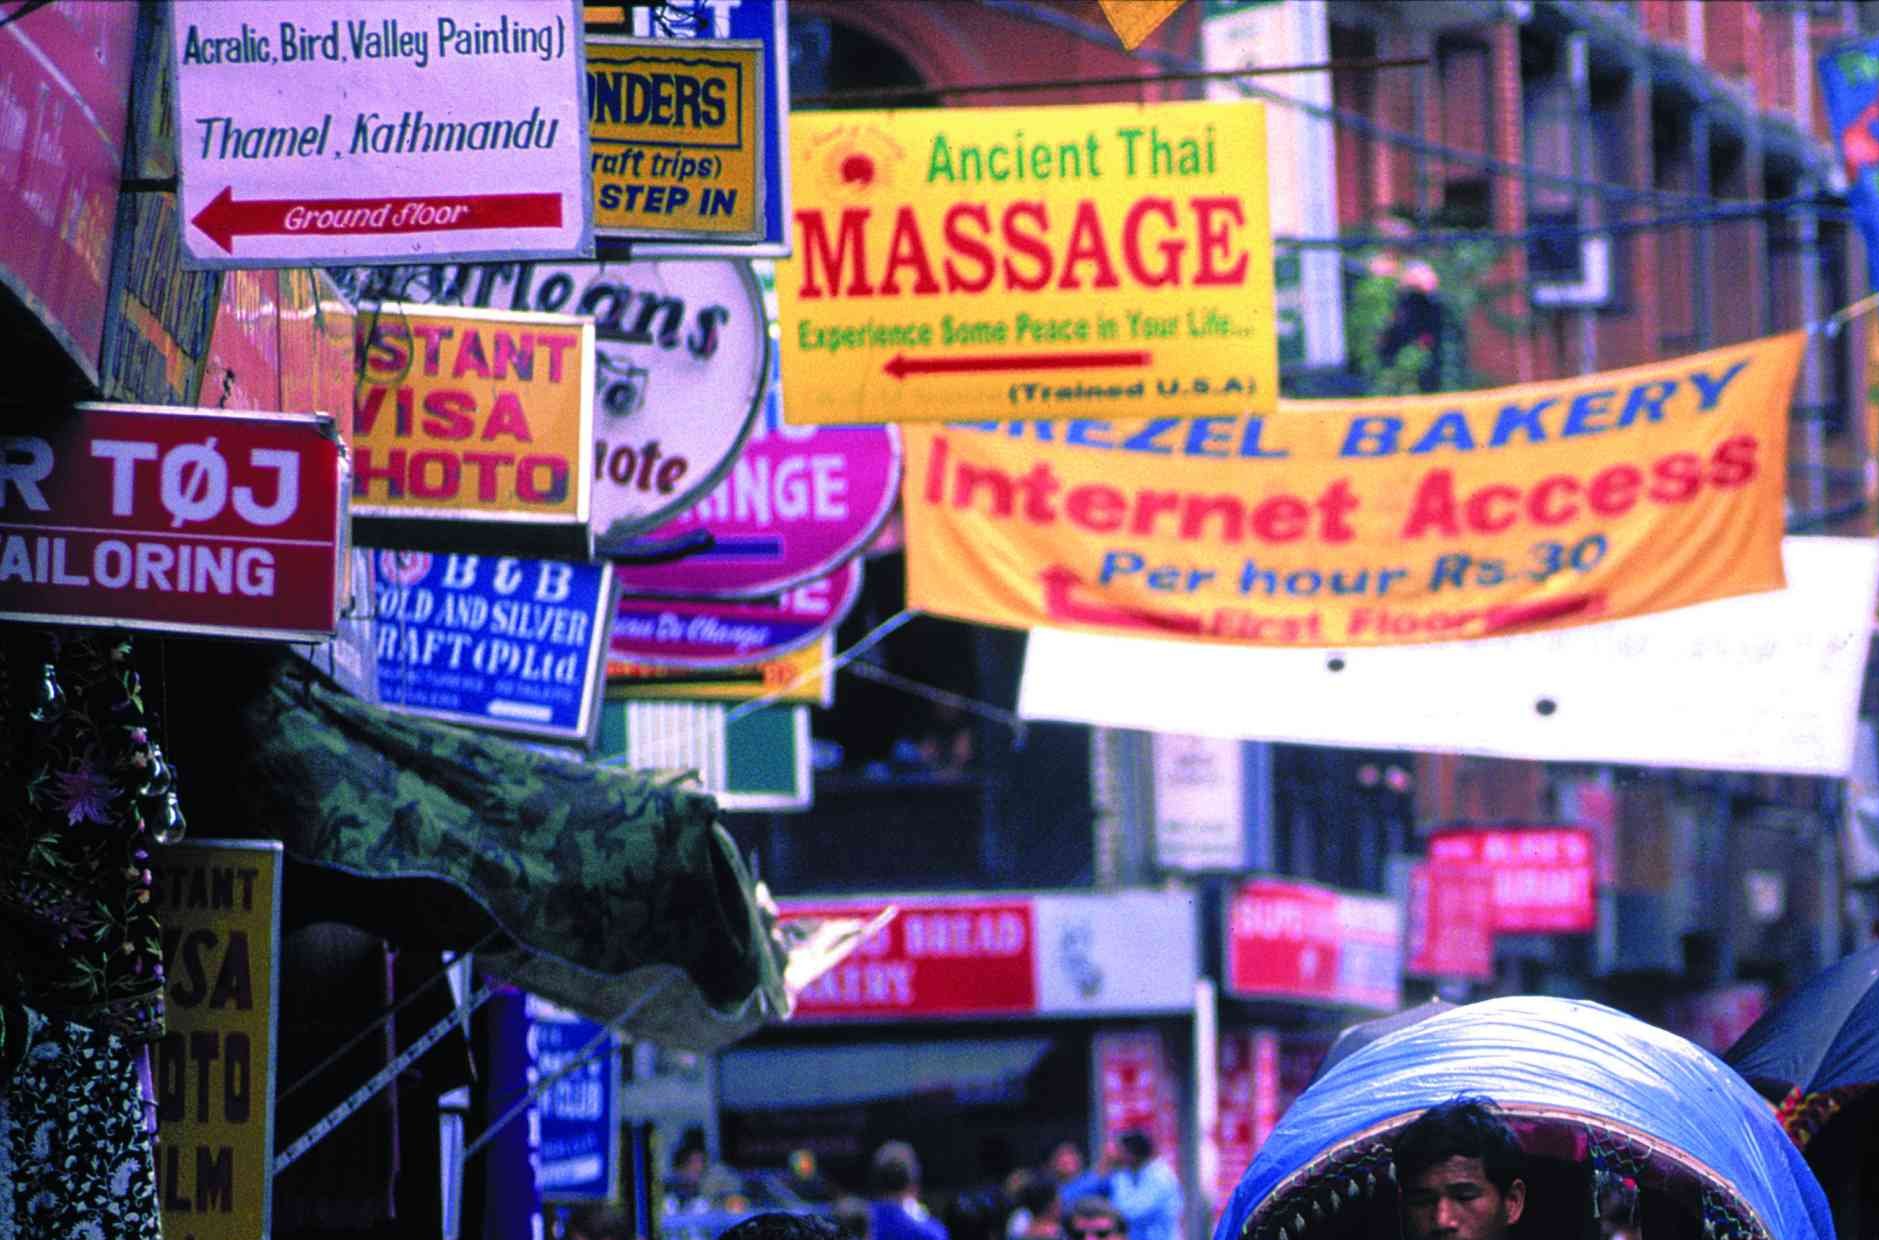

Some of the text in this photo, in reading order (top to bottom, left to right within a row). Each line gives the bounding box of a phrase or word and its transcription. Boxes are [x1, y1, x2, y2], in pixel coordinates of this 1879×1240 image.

[348, 19, 429, 68] Valley
[438, 15, 565, 60] Painting)
[587, 71, 727, 129] NDERS
[350, 107, 559, 155] Kathmandu
[926, 129, 1102, 184] Ancient
[1117, 124, 1217, 177] Thai
[651, 150, 723, 182] trips)
[284, 202, 470, 230] Ground floor
[600, 184, 738, 216] STEP IN
[794, 194, 1250, 300] MASSAGE
[355, 319, 578, 383] STANT
[798, 319, 933, 353] Experience
[941, 314, 1008, 346] Some
[1015, 312, 1089, 344] Peace
[1097, 314, 1119, 339] in
[1126, 309, 1178, 339] Your
[352, 385, 533, 443] VISA
[945, 358, 1750, 459] EZEL BAKERY
[1008, 379, 1145, 405] (Trained
[90, 436, 300, 528] TØJ
[682, 453, 850, 528] ANGE
[926, 433, 1760, 544] Internet Access
[0, 533, 276, 598] AILORING
[534, 560, 574, 603] B
[1100, 551, 1216, 591] Per
[1239, 557, 1409, 595] hour
[376, 582, 589, 647] OLD AND SILVER
[156, 1145, 233, 1213] LM
